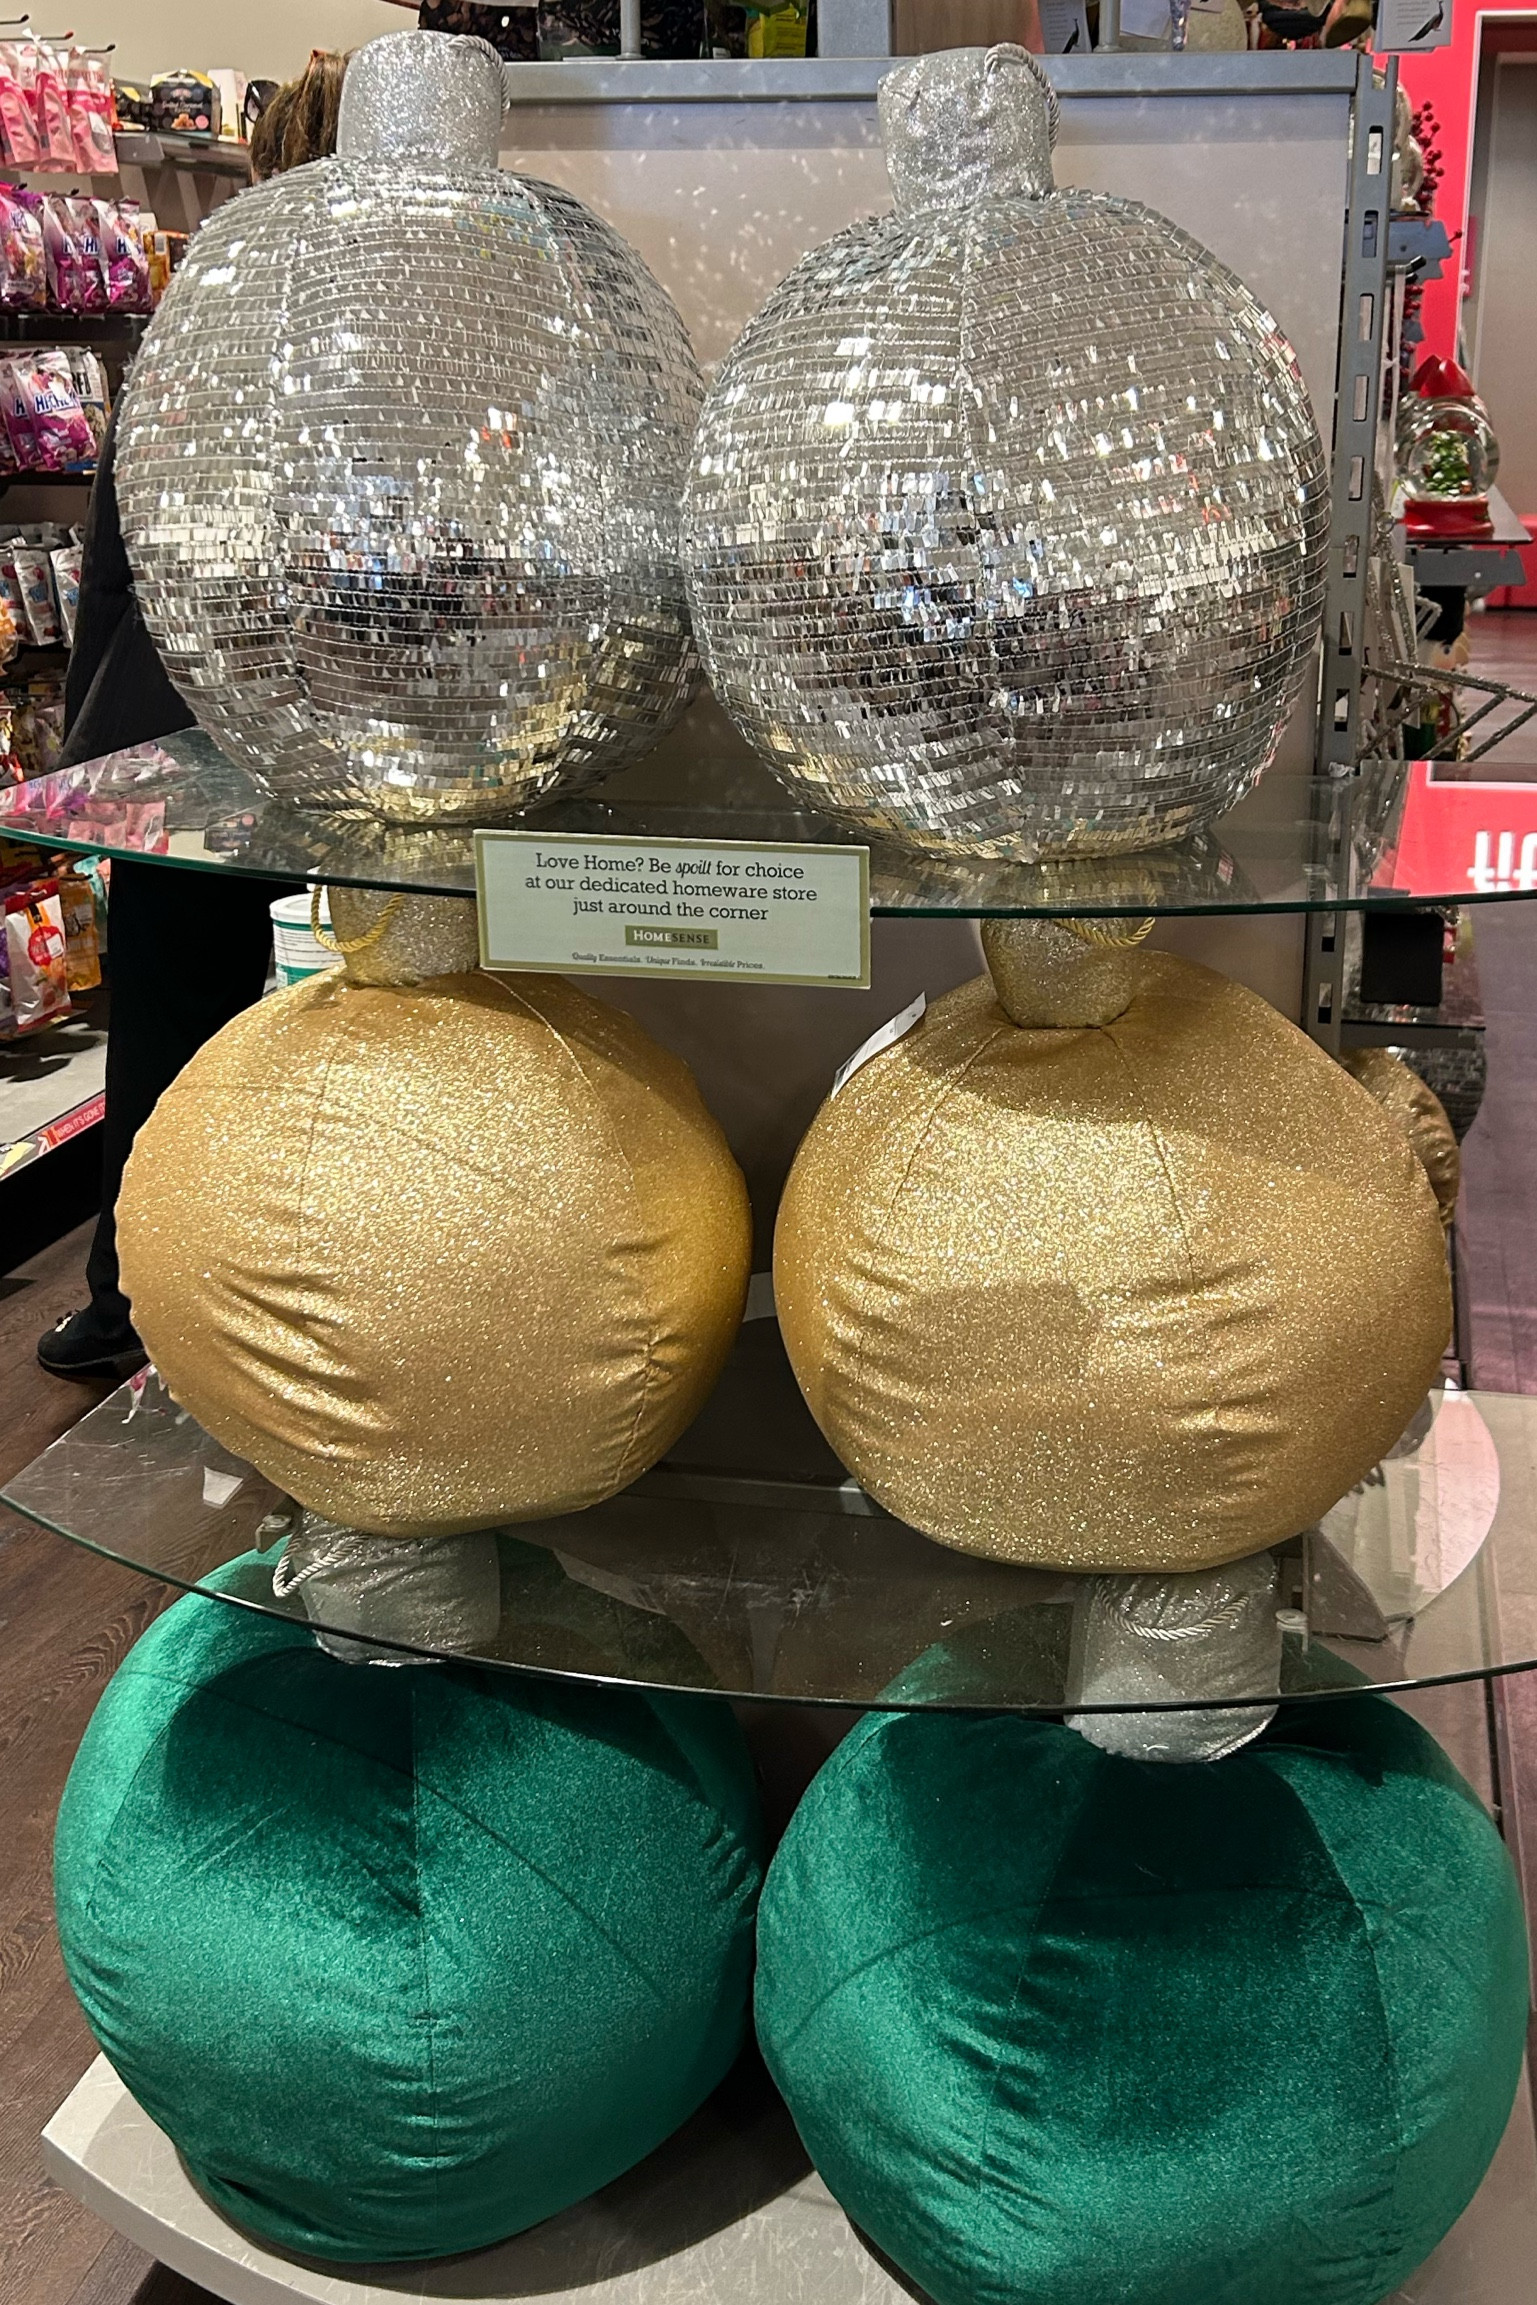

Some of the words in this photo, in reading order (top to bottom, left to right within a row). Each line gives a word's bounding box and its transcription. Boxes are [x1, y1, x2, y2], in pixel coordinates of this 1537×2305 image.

[536, 853, 579, 869] Love
[584, 855, 644, 872] Home?
[649, 858, 671, 873] Be
[676, 860, 711, 878] spoilt
[716, 861, 740, 876] for
[745, 862, 804, 879] choice
[525, 876, 541, 889] at
[545, 878, 575, 890] our
[580, 877, 668, 895] dedicated
[672, 880, 768, 899] homeware
[773, 886, 817, 901] store
[573, 897, 603, 916] just
[608, 901, 672, 916] around
[677, 902, 704, 918] the
[709, 906, 769, 920] corner
[633, 930, 710, 944] HOMESENSE
[572, 952, 597, 963] Quality
[646, 955, 671, 967] Unique
